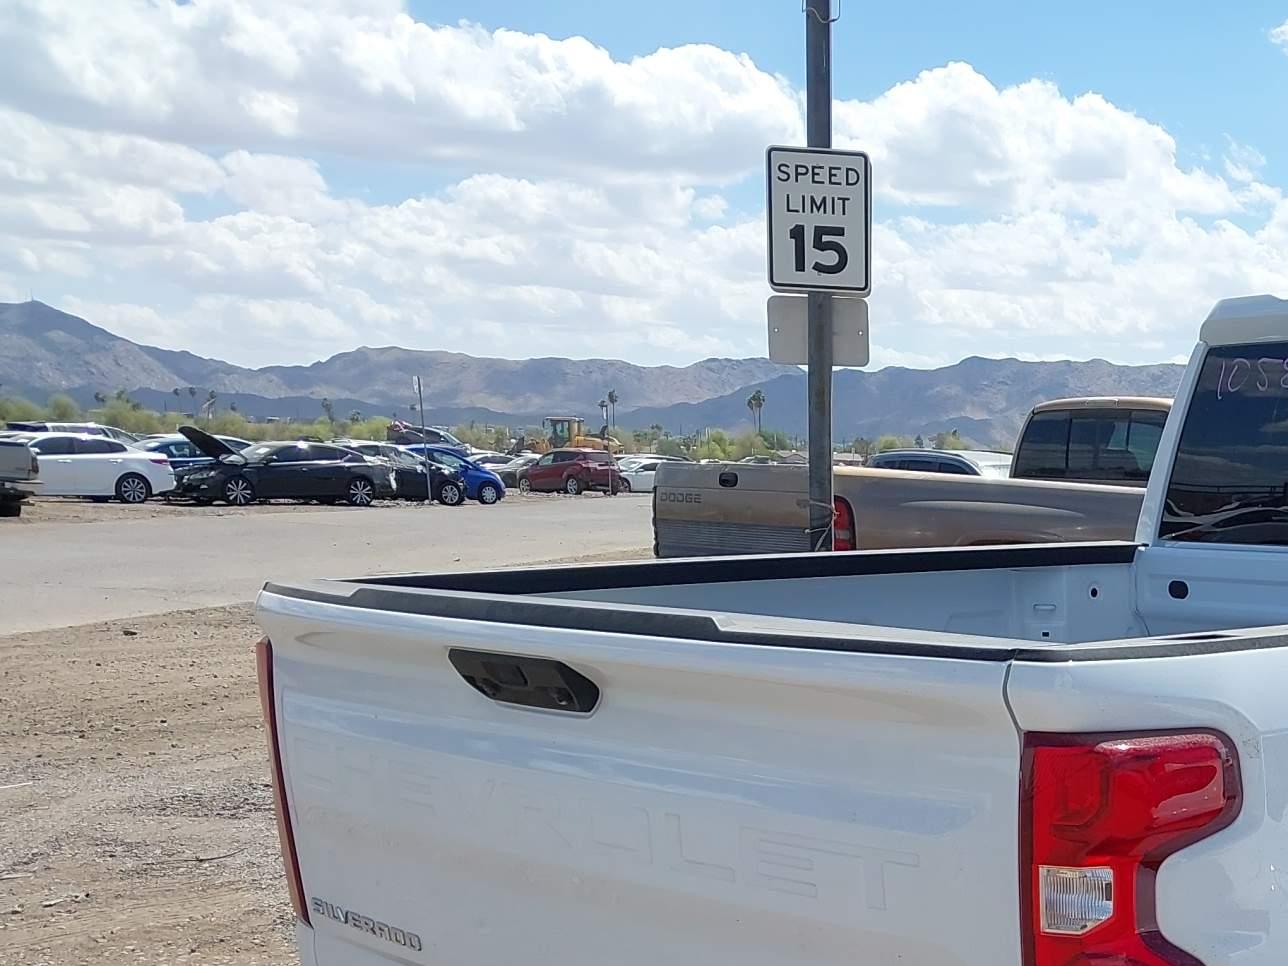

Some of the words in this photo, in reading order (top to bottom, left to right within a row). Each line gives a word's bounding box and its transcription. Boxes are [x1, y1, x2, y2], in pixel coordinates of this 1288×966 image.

[776, 163, 861, 187] SPEED
[785, 193, 851, 216] LIMIT
[789, 223, 849, 275] 15
[659, 492, 703, 504] DODGE
[311, 896, 423, 951] SILVERADO
